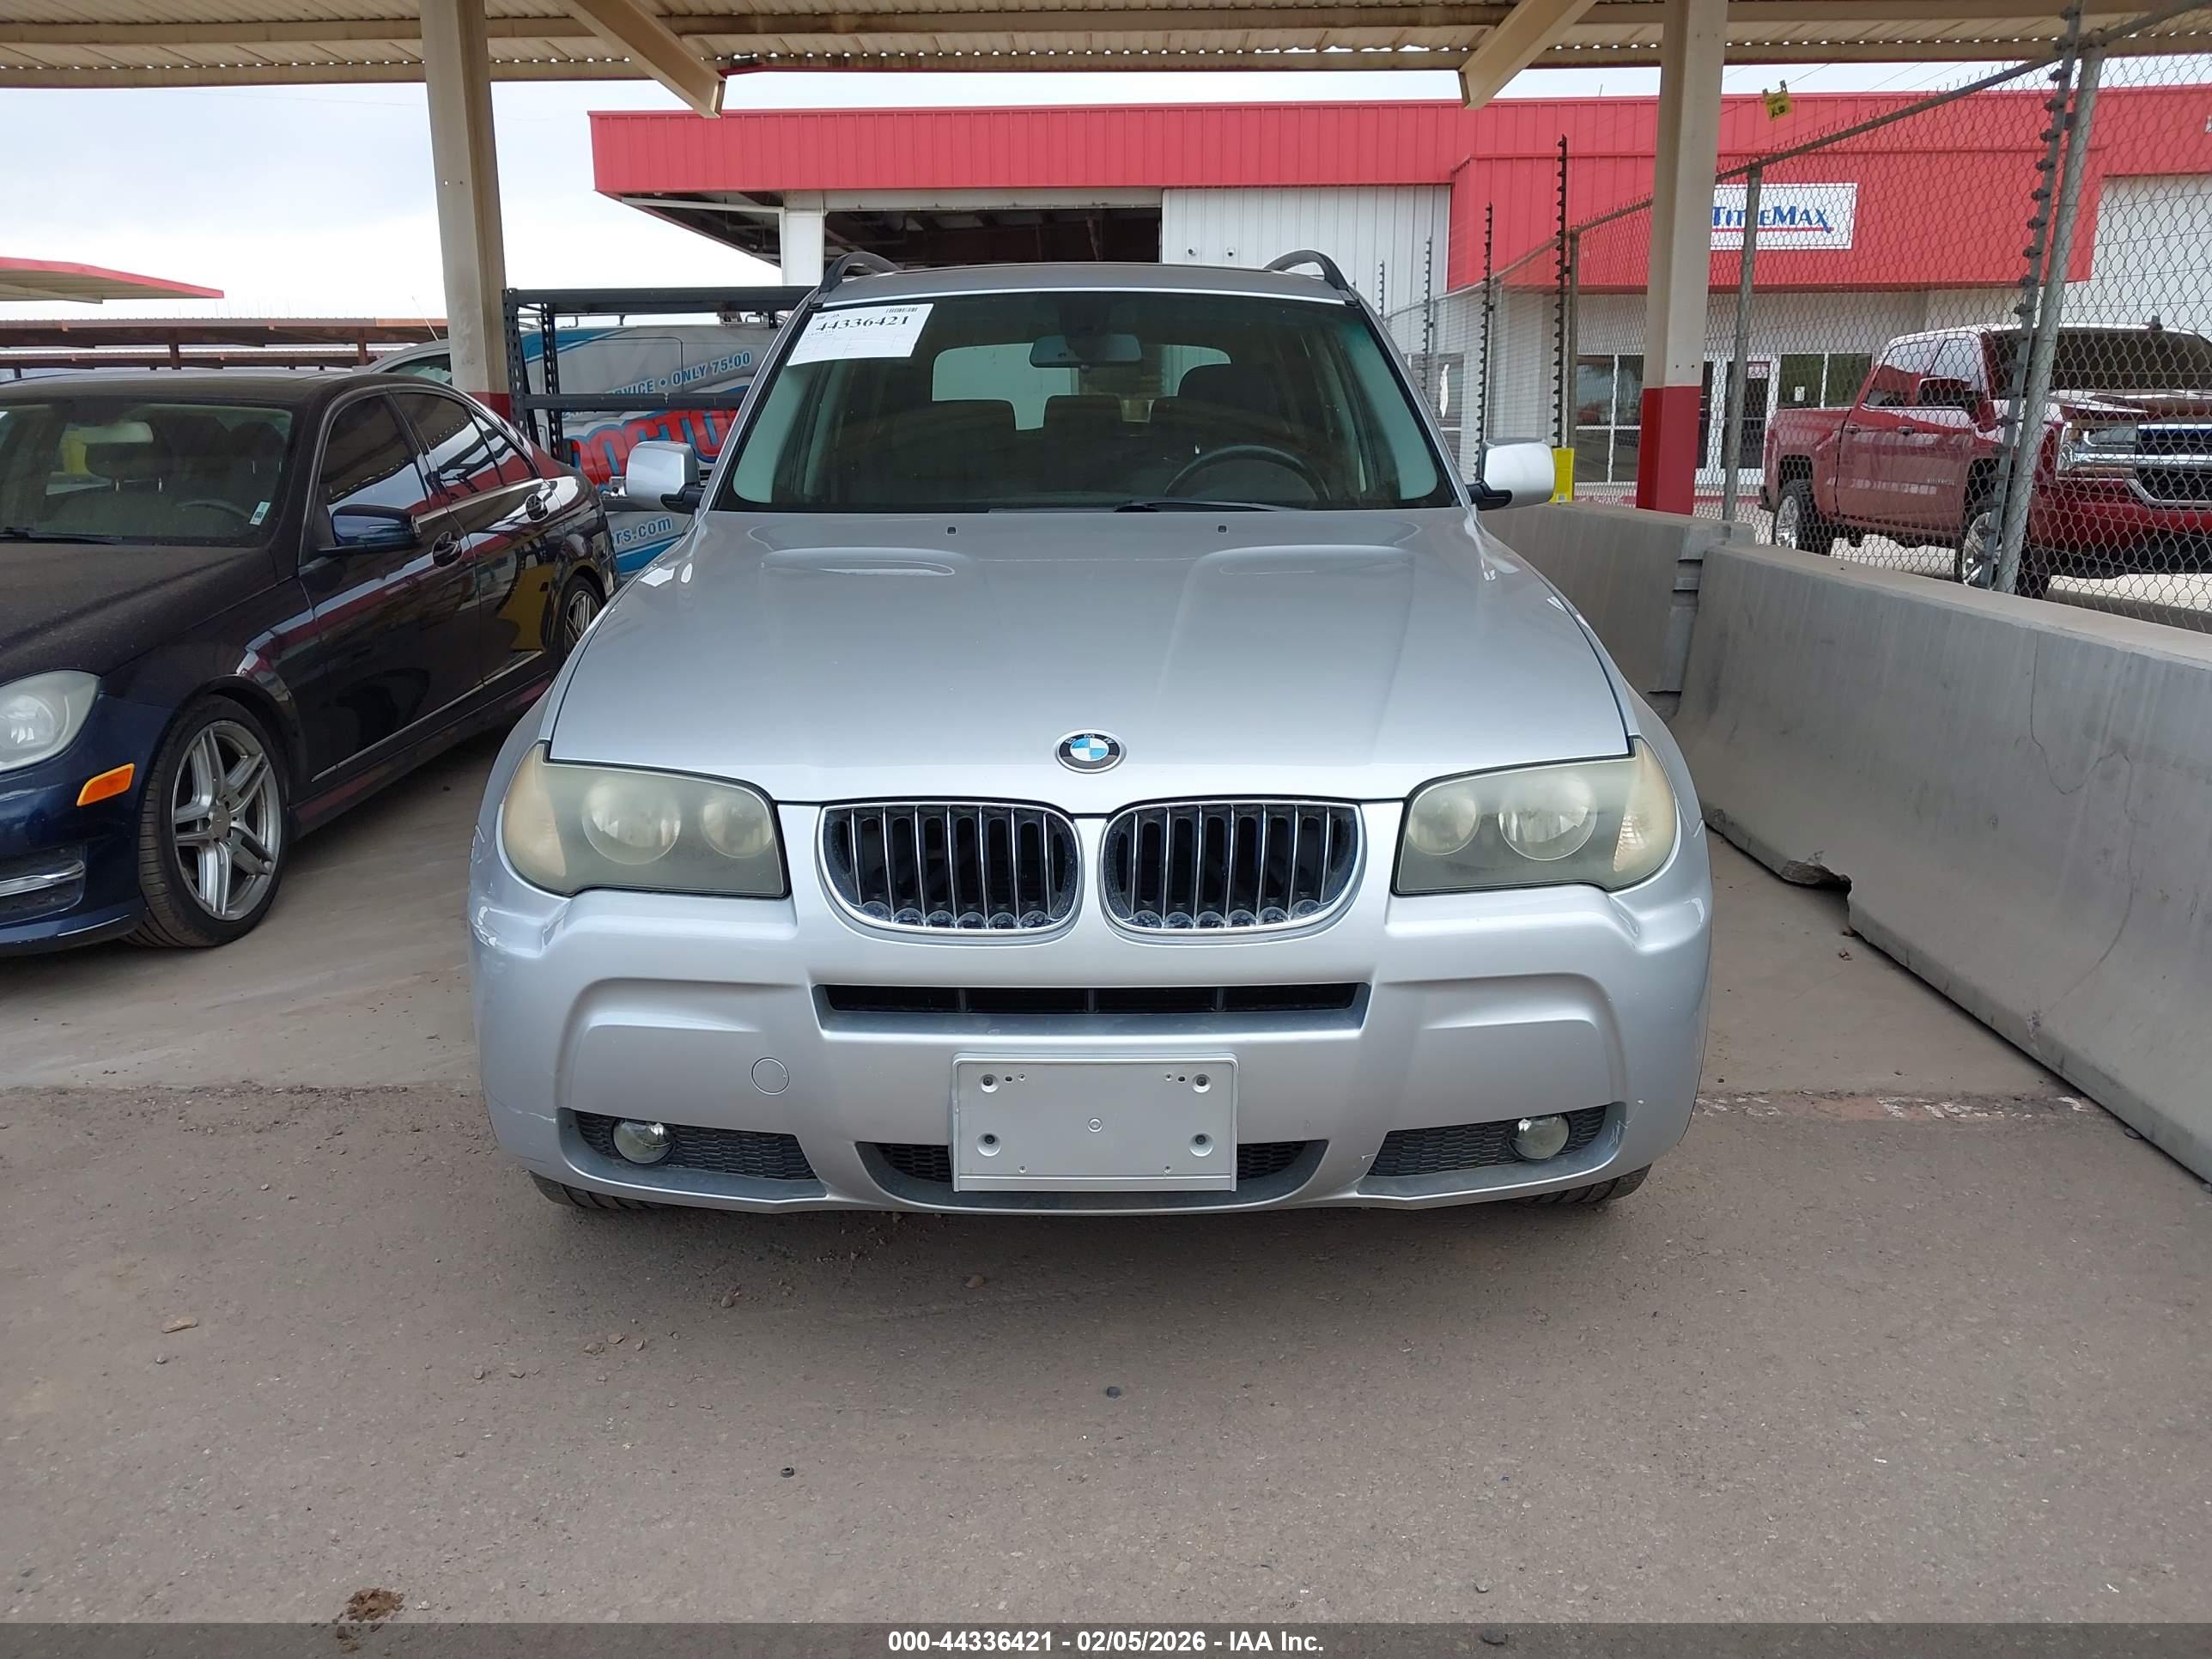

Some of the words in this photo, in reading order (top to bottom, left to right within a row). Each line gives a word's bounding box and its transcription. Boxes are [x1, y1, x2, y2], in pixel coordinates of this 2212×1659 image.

[815, 314, 909, 332] 44336421
[672, 364, 706, 385] ONLY
[1064, 733, 1115, 744] BMW
